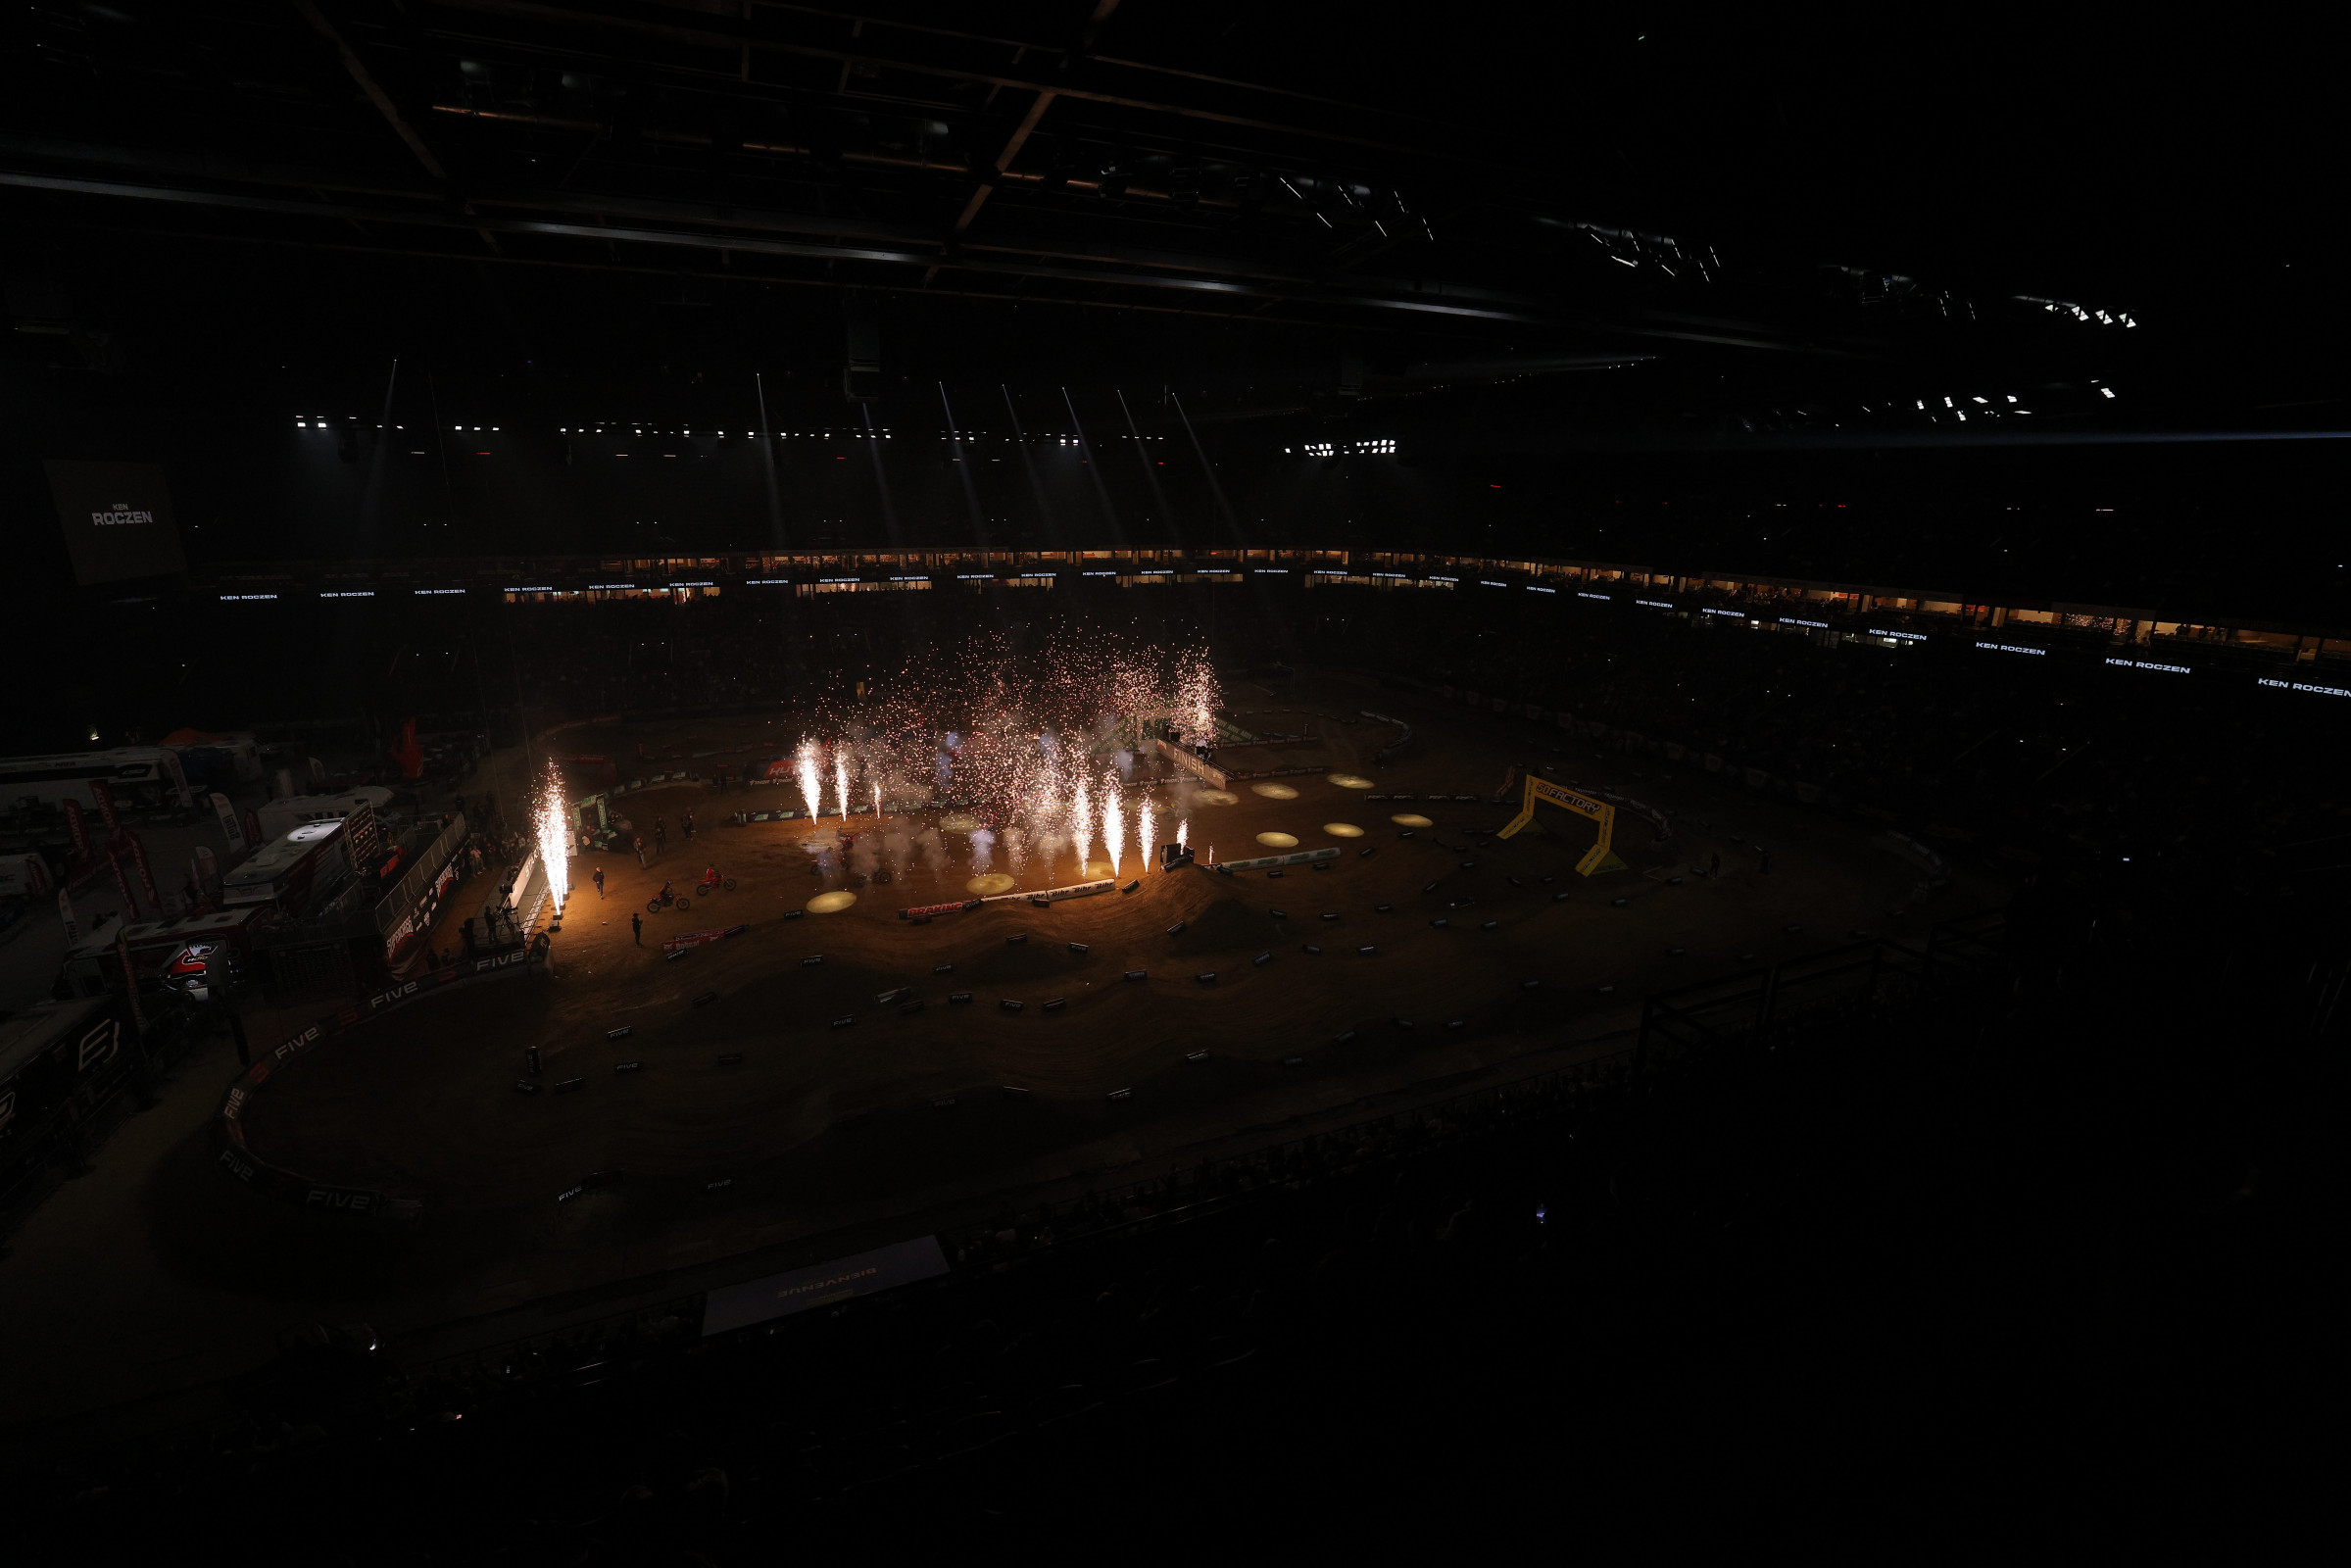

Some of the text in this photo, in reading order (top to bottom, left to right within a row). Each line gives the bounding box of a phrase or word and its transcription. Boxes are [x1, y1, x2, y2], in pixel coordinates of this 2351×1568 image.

[92, 511, 154, 526] ROCZEN
[2001, 646, 2045, 655] ROCZEN
[2136, 662, 2190, 673] ROCZEN
[2258, 678, 2288, 688] KEN
[1174, 749, 1204, 774] FINISH
[909, 903, 962, 916] BRAKING
[477, 952, 524, 971] FIVE
[371, 981, 418, 1008] FIVE
[275, 1027, 319, 1059] FIVE
[223, 1088, 245, 1119] FIVE
[219, 1150, 254, 1182] FIVE
[558, 1186, 582, 1202] FIVE
[708, 1179, 732, 1190] FIVE
[306, 1190, 371, 1210] FIVE
[777, 1267, 878, 1300] BIENVENUE
